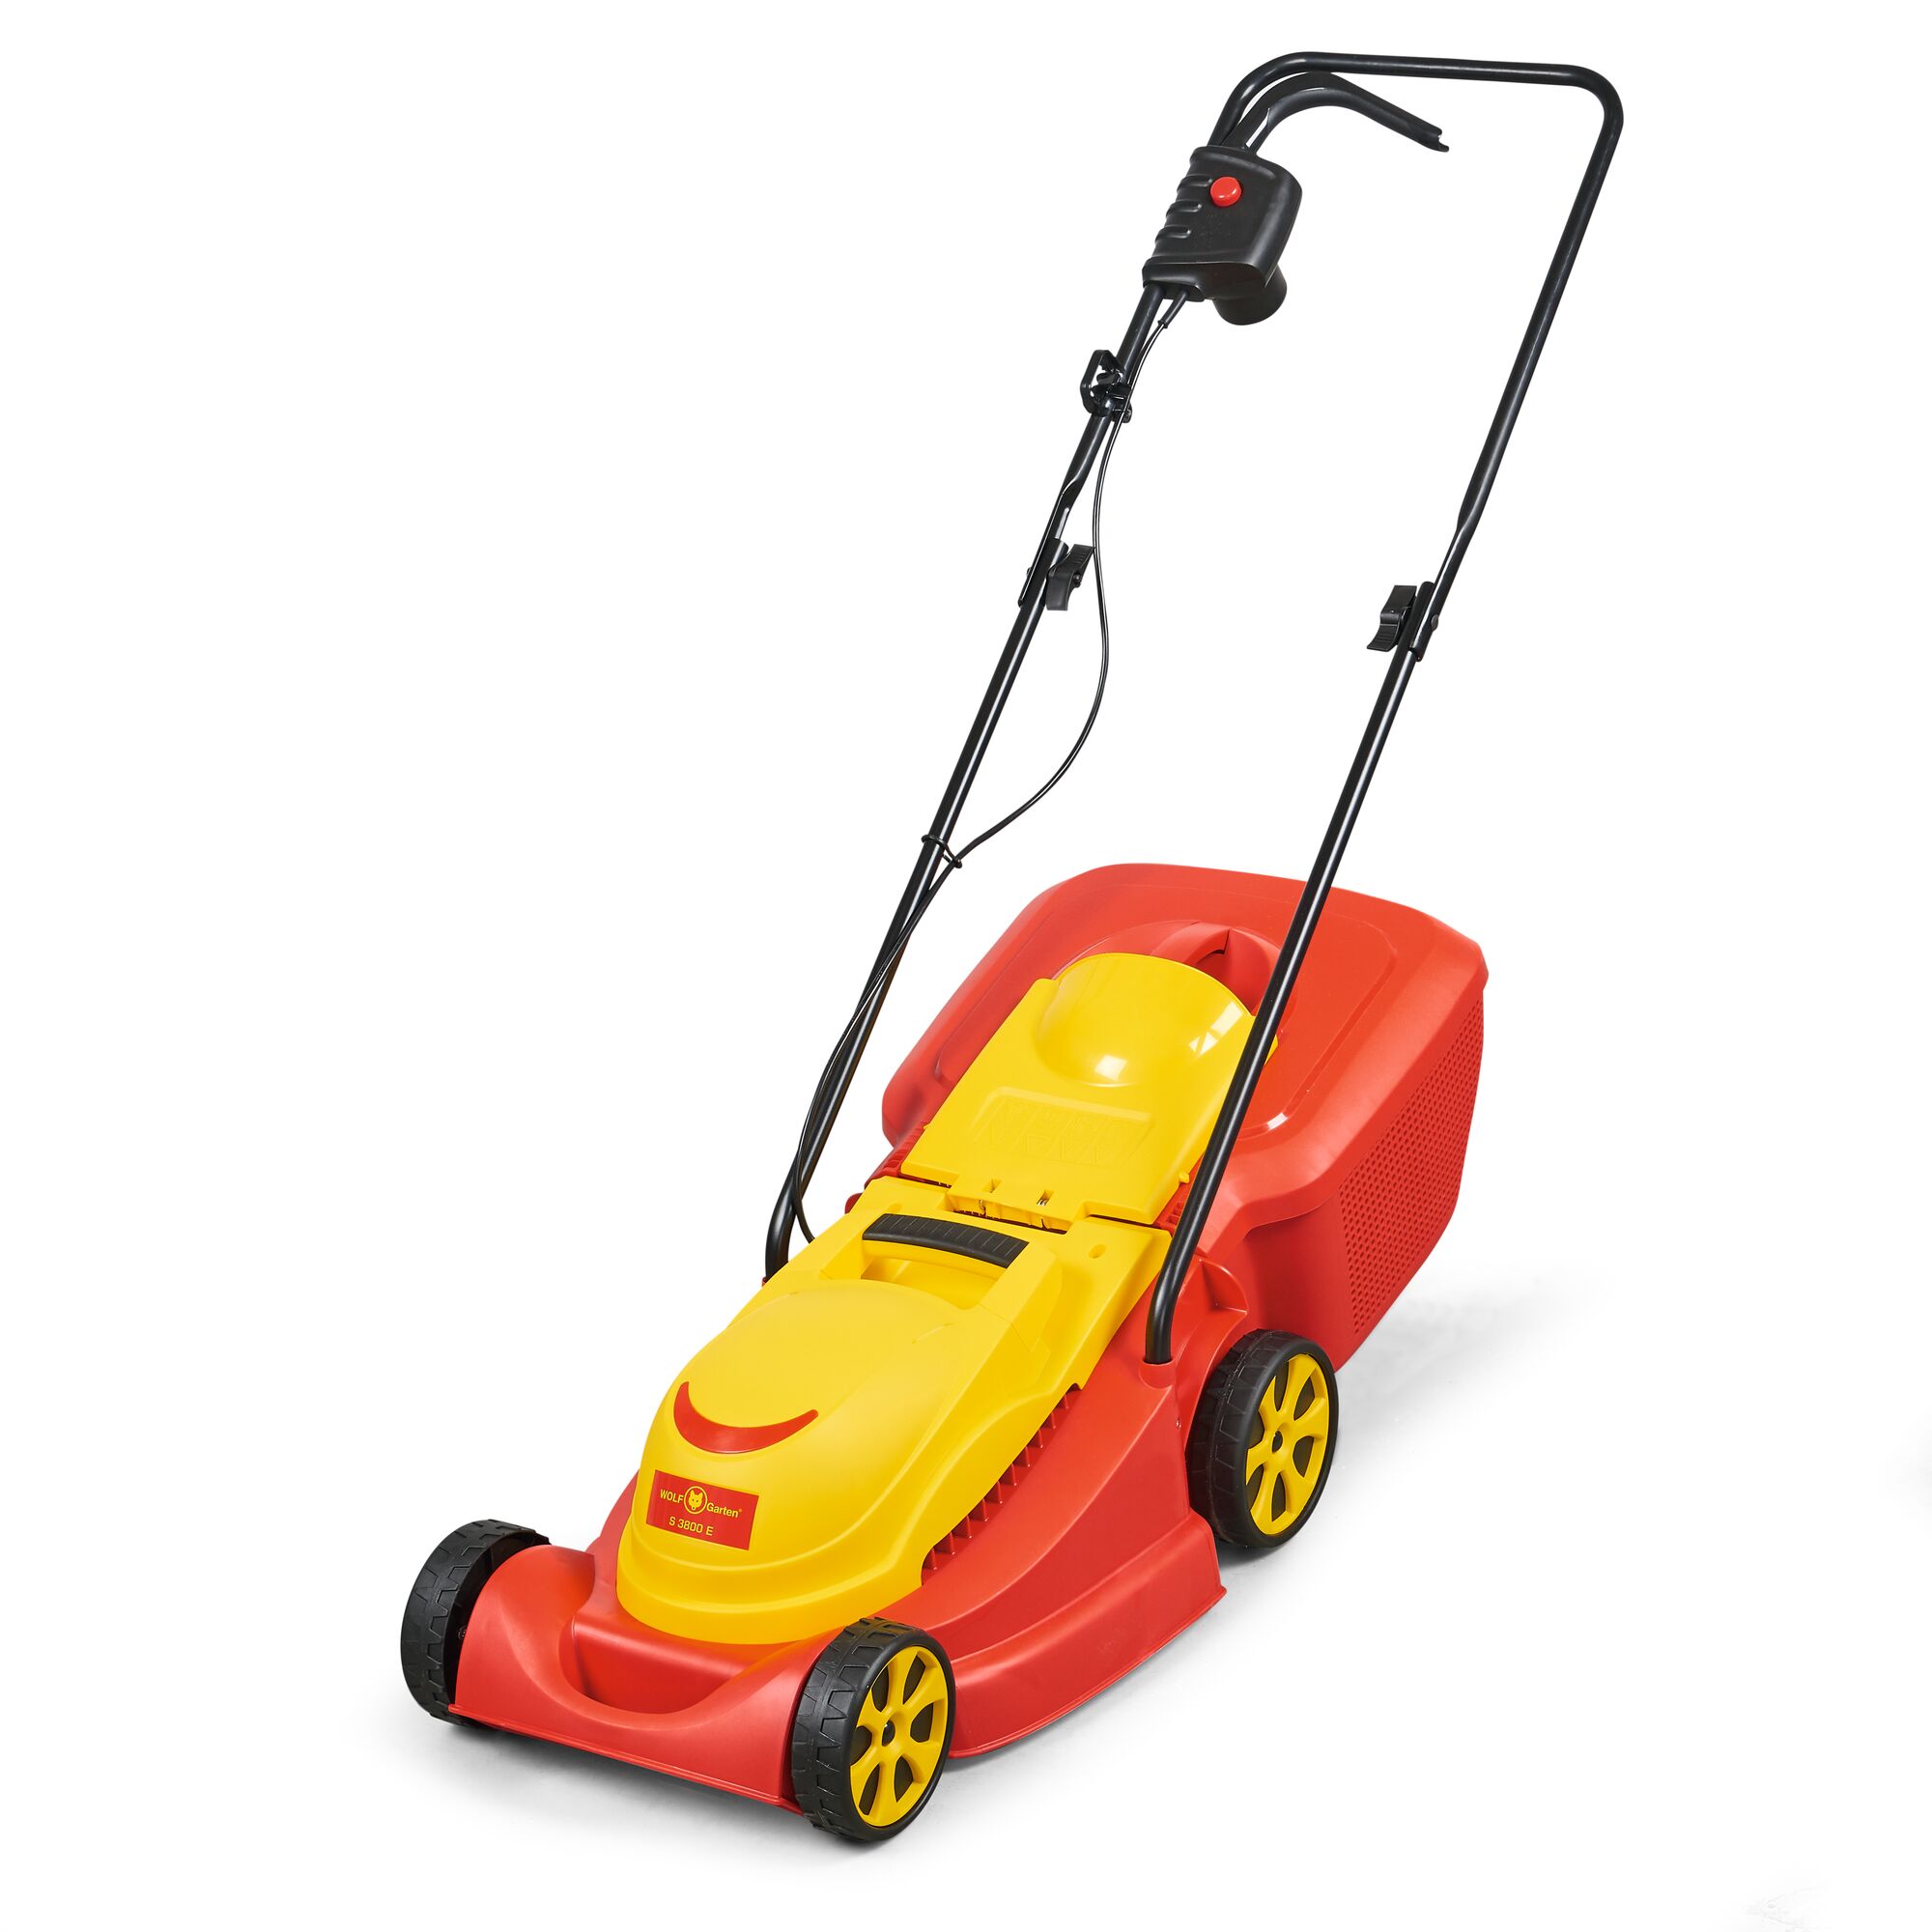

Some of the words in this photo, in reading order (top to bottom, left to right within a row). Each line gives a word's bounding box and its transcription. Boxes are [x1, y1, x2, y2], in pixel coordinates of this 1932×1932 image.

[660, 1489, 684, 1504] WOLF
[668, 1516, 676, 1526] S
[677, 1519, 703, 1534] 3800
[705, 1525, 714, 1536] E
